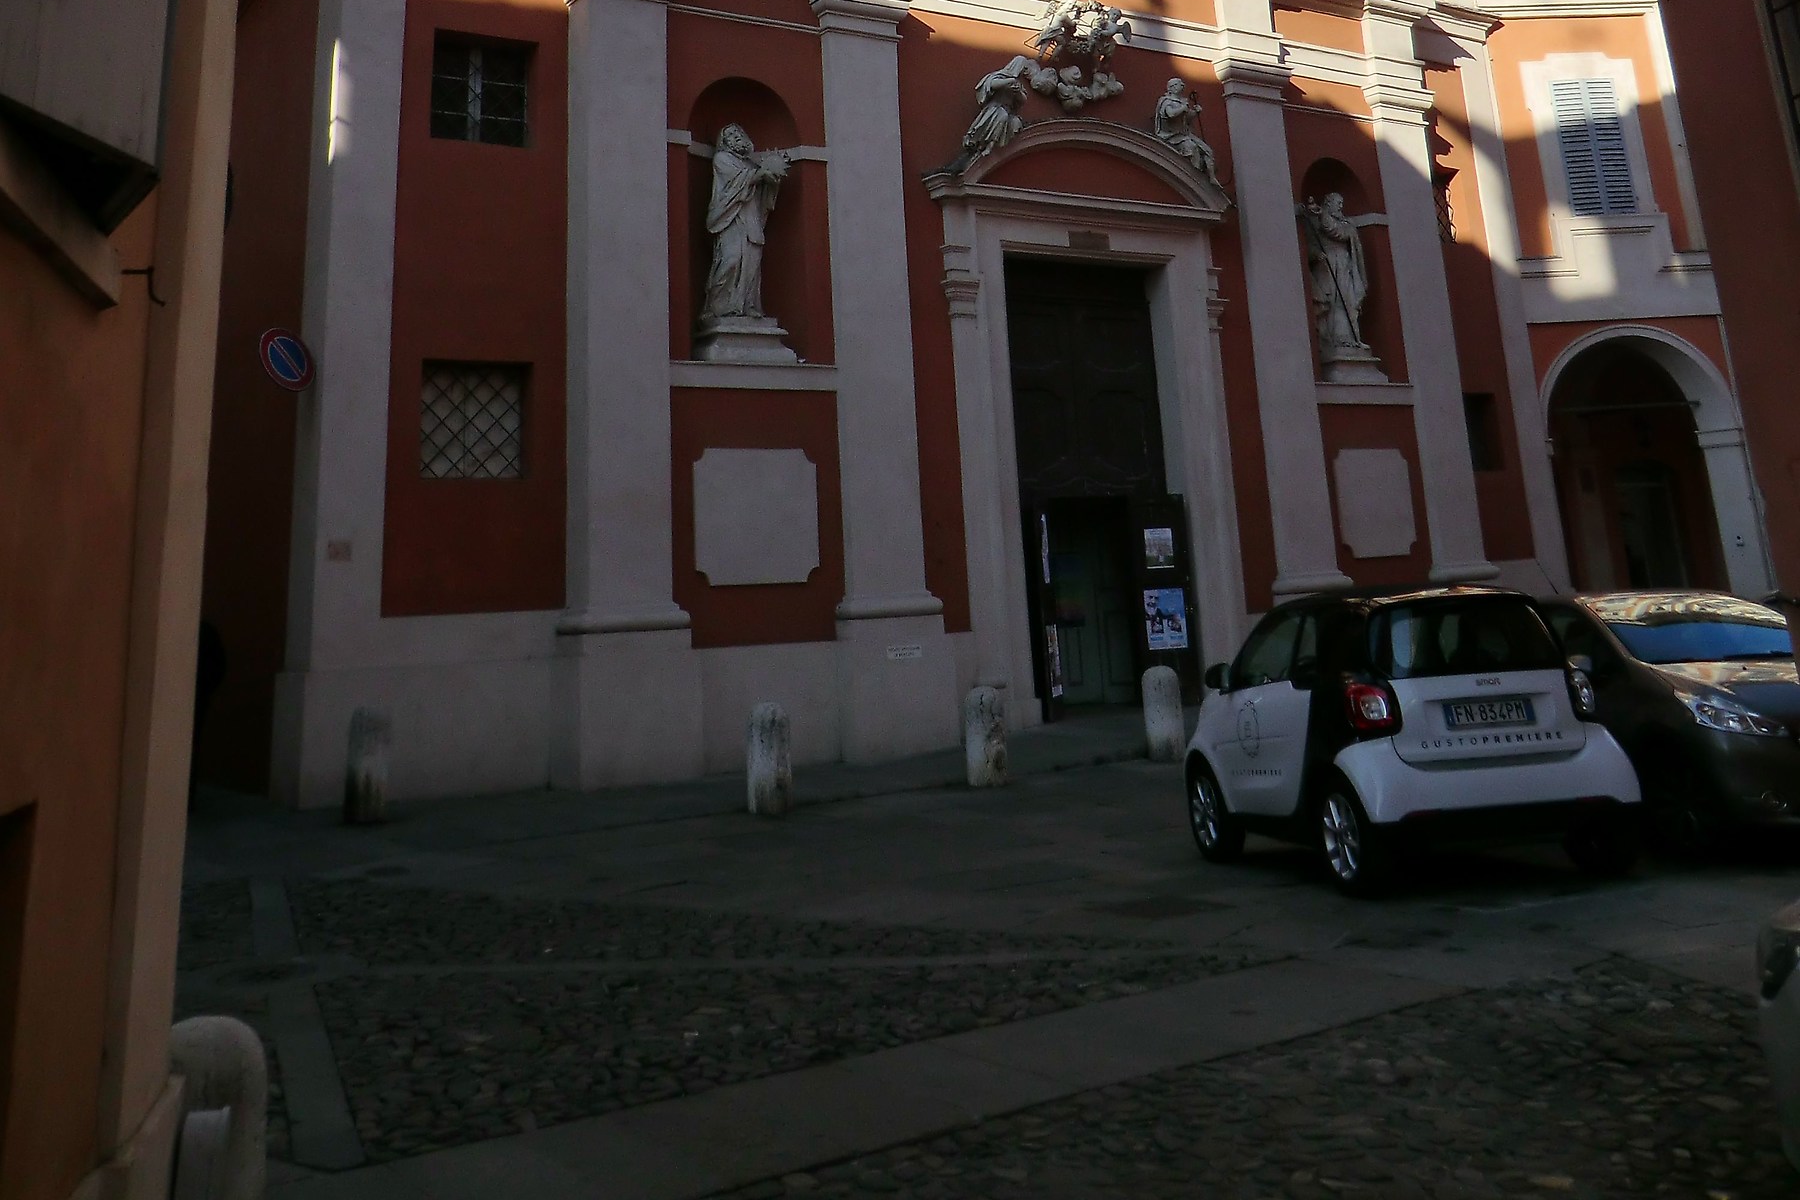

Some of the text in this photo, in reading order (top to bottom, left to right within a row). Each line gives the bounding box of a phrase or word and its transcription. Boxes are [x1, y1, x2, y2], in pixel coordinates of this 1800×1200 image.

[1475, 678, 1500, 687] smart
[1453, 703, 1475, 723] FN
[1421, 731, 1564, 749] GUSTOPREMIERE
